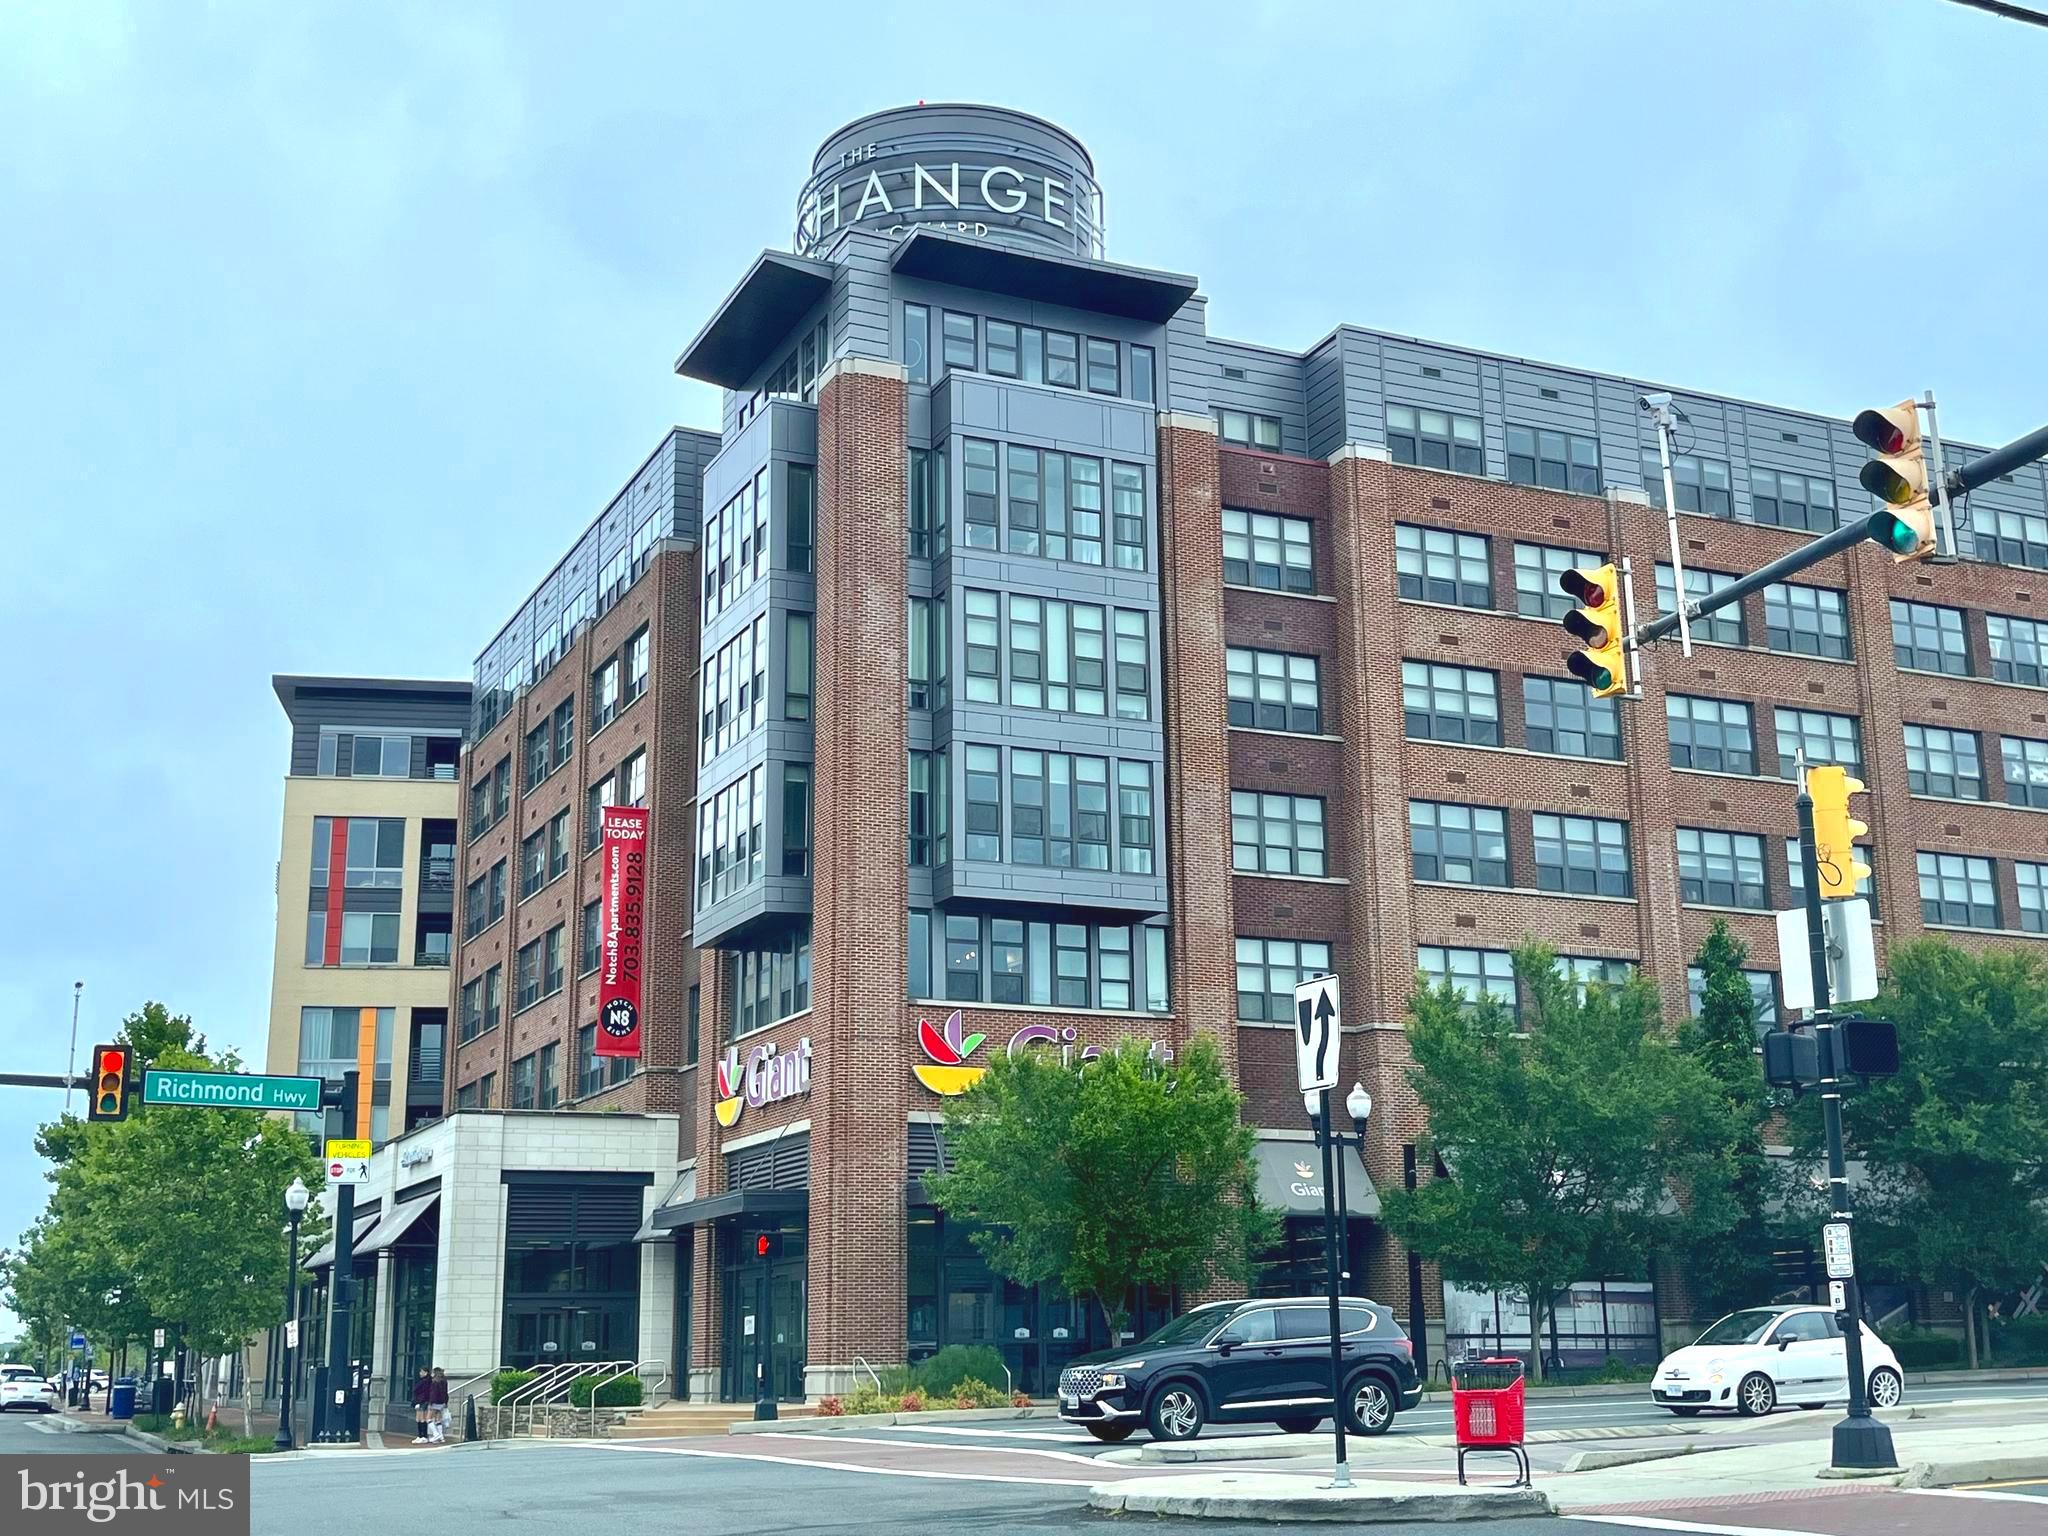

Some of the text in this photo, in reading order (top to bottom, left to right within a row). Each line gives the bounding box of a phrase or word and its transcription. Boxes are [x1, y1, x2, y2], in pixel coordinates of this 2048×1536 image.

[839, 142, 877, 168] THE
[606, 829, 645, 840] TODAY
[608, 818, 643, 829] LEASE
[605, 846, 622, 985] Notch8Apartments.com
[623, 852, 643, 982] 703.835.9128
[606, 1000, 633, 1011] NOTCH
[610, 1010, 630, 1026] N8
[745, 1037, 812, 1107] Giant
[157, 1077, 307, 1106] Richmond Hwy
